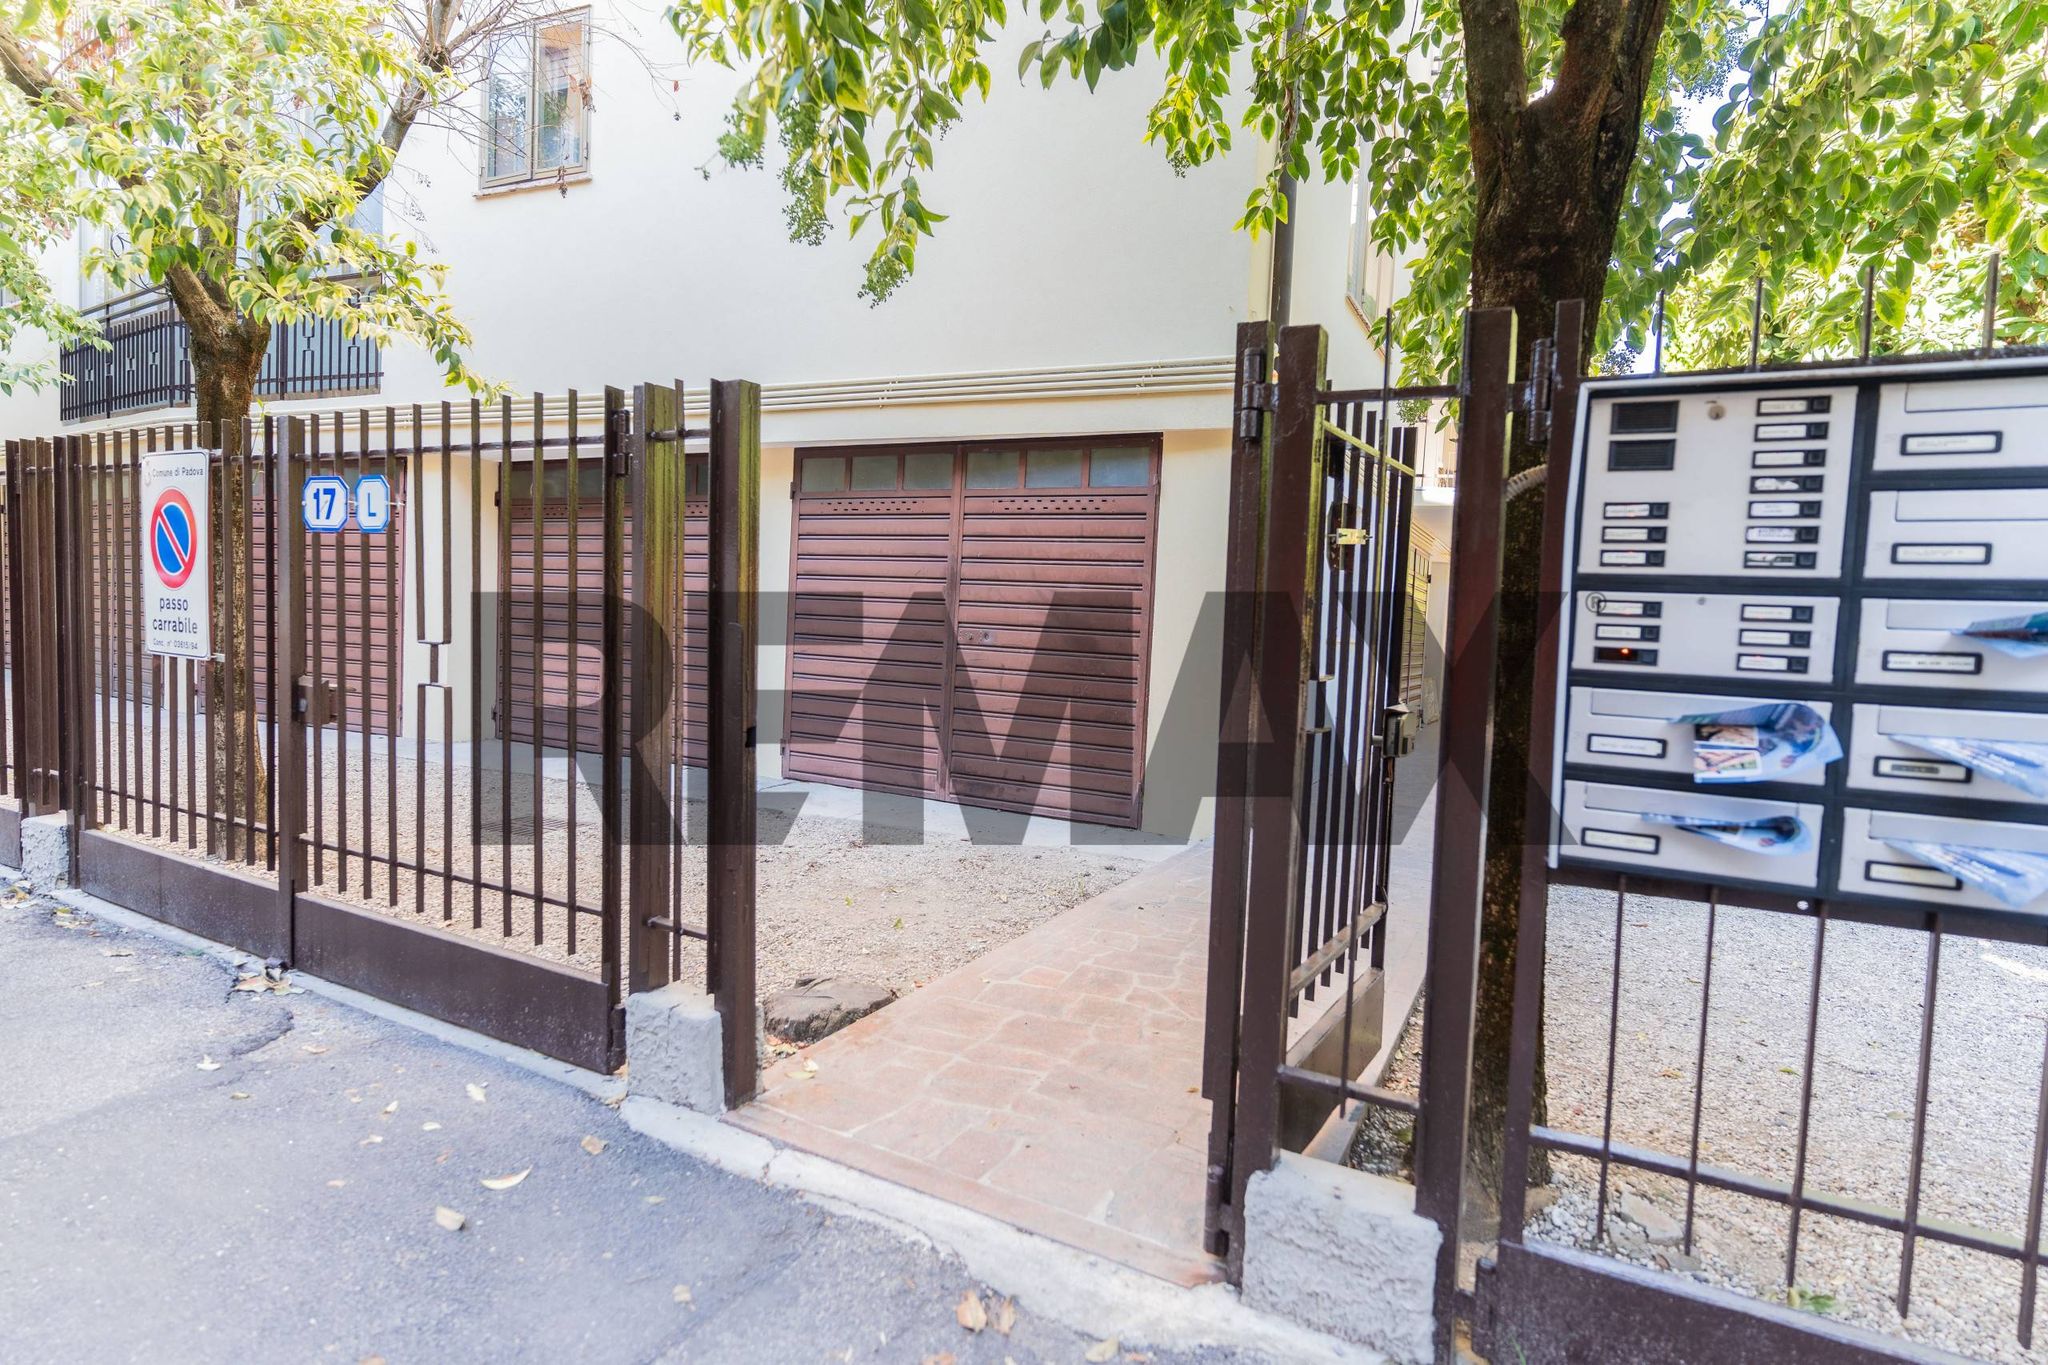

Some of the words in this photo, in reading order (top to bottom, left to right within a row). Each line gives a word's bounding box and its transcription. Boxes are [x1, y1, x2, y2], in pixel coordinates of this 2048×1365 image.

[152, 468, 173, 478] Comune
[174, 467, 181, 477] di
[181, 466, 204, 476] Padova
[313, 488, 336, 520] 17
[368, 492, 377, 517] L
[159, 597, 189, 612] passo
[152, 616, 198, 634] carrabile
